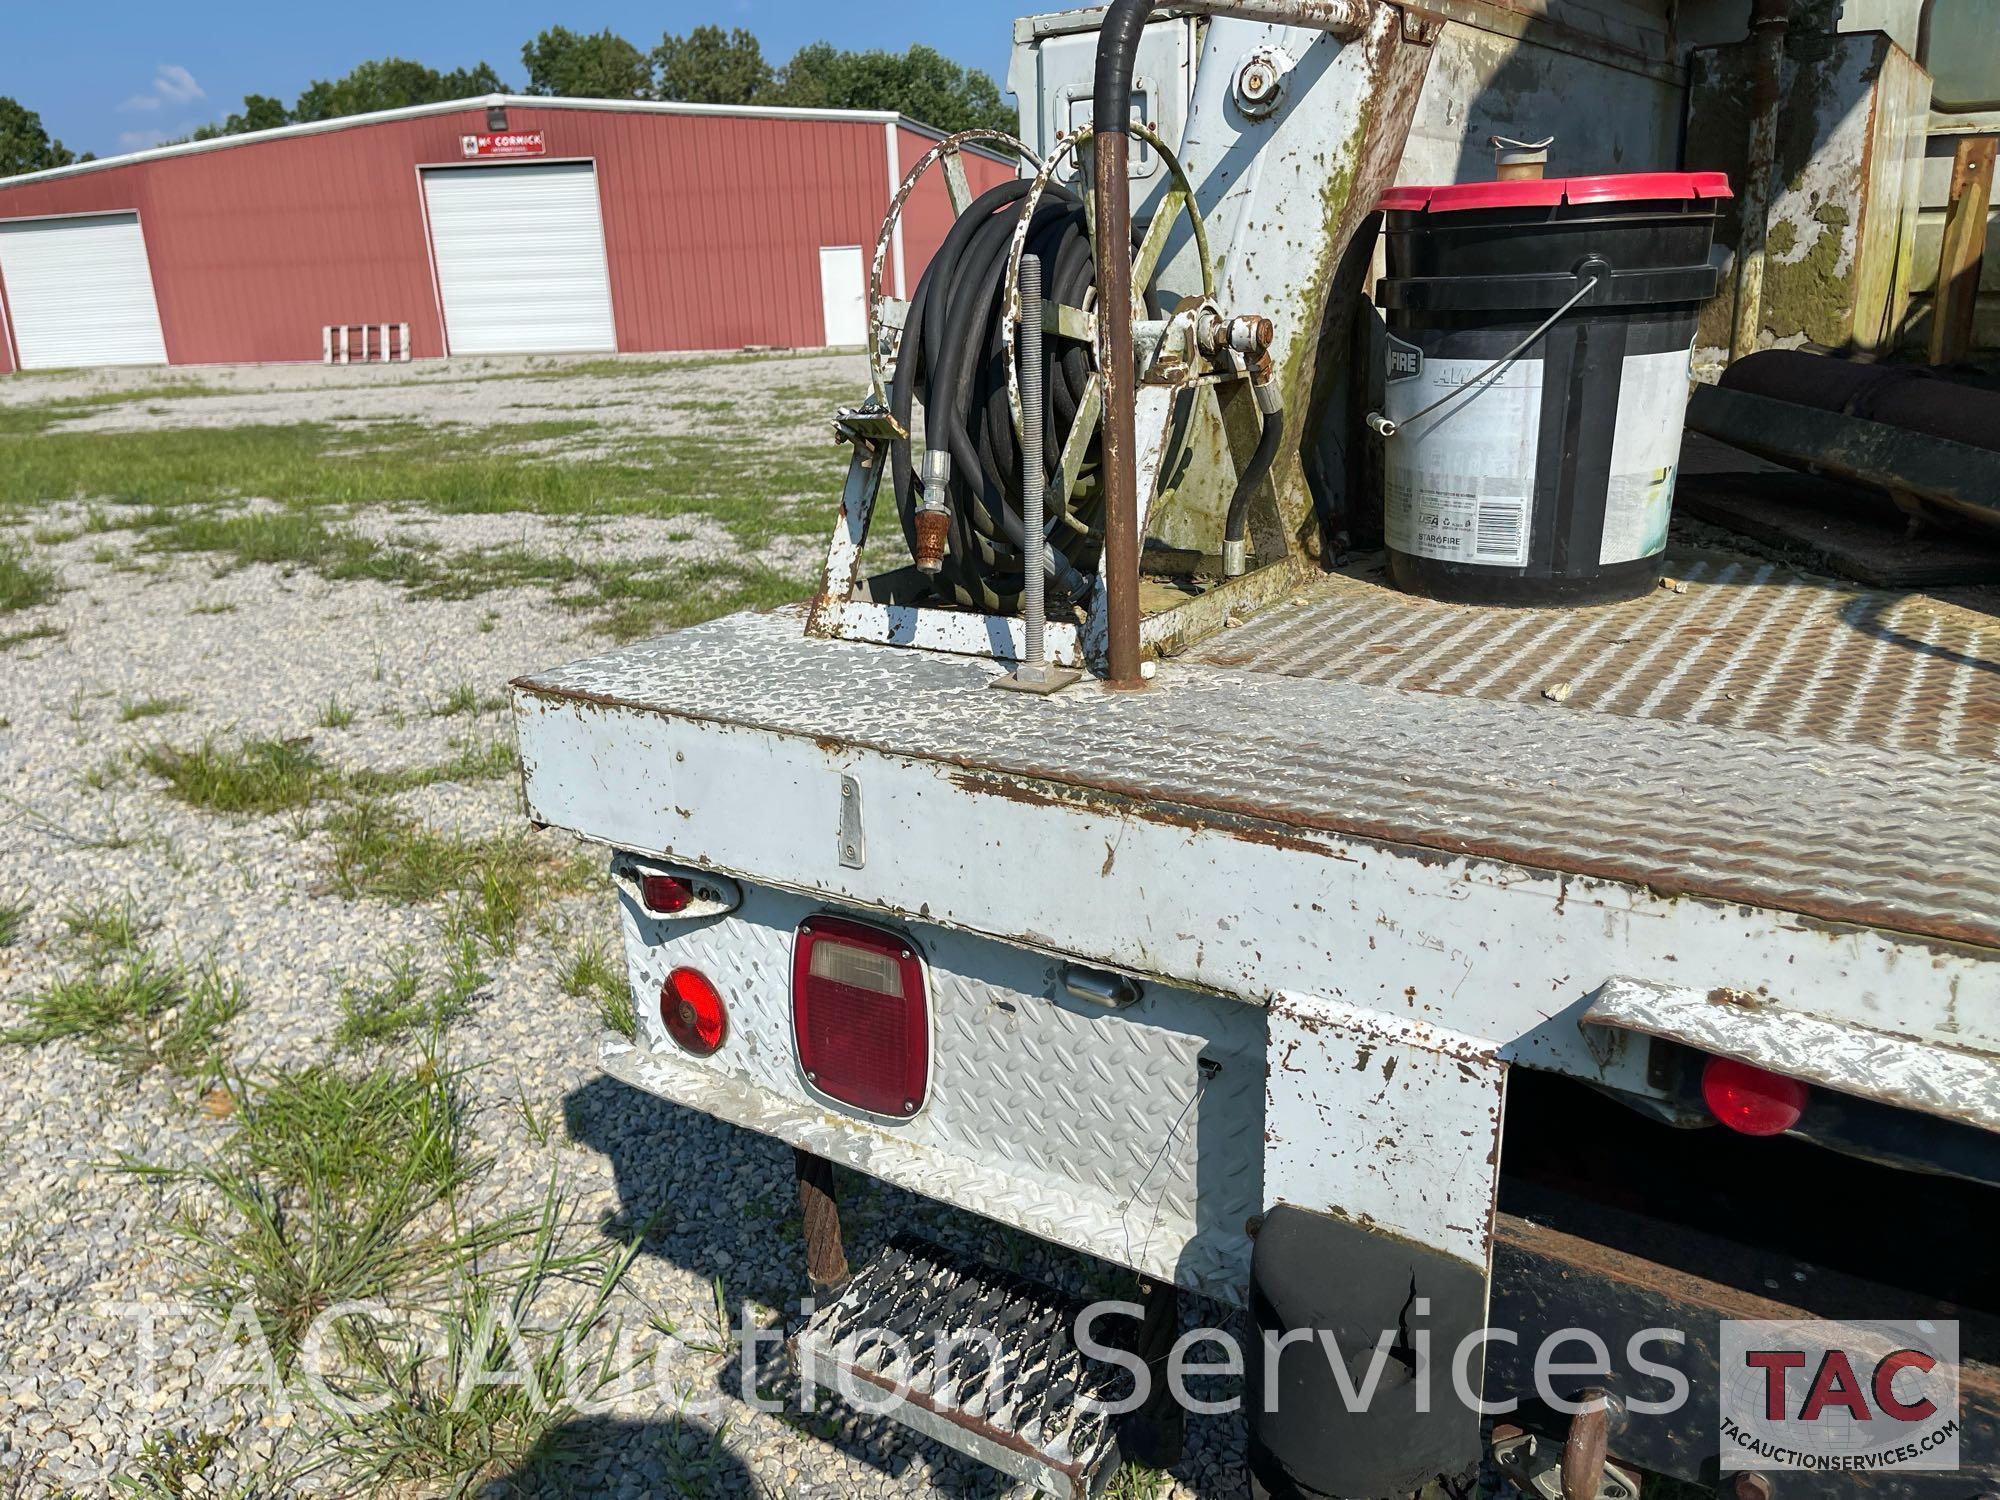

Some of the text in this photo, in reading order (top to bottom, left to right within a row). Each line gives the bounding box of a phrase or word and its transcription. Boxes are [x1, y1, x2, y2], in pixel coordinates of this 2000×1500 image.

[495, 135, 541, 146] CORMICK
[1391, 350, 1417, 373] FIRE
[1418, 514, 1439, 526] USA
